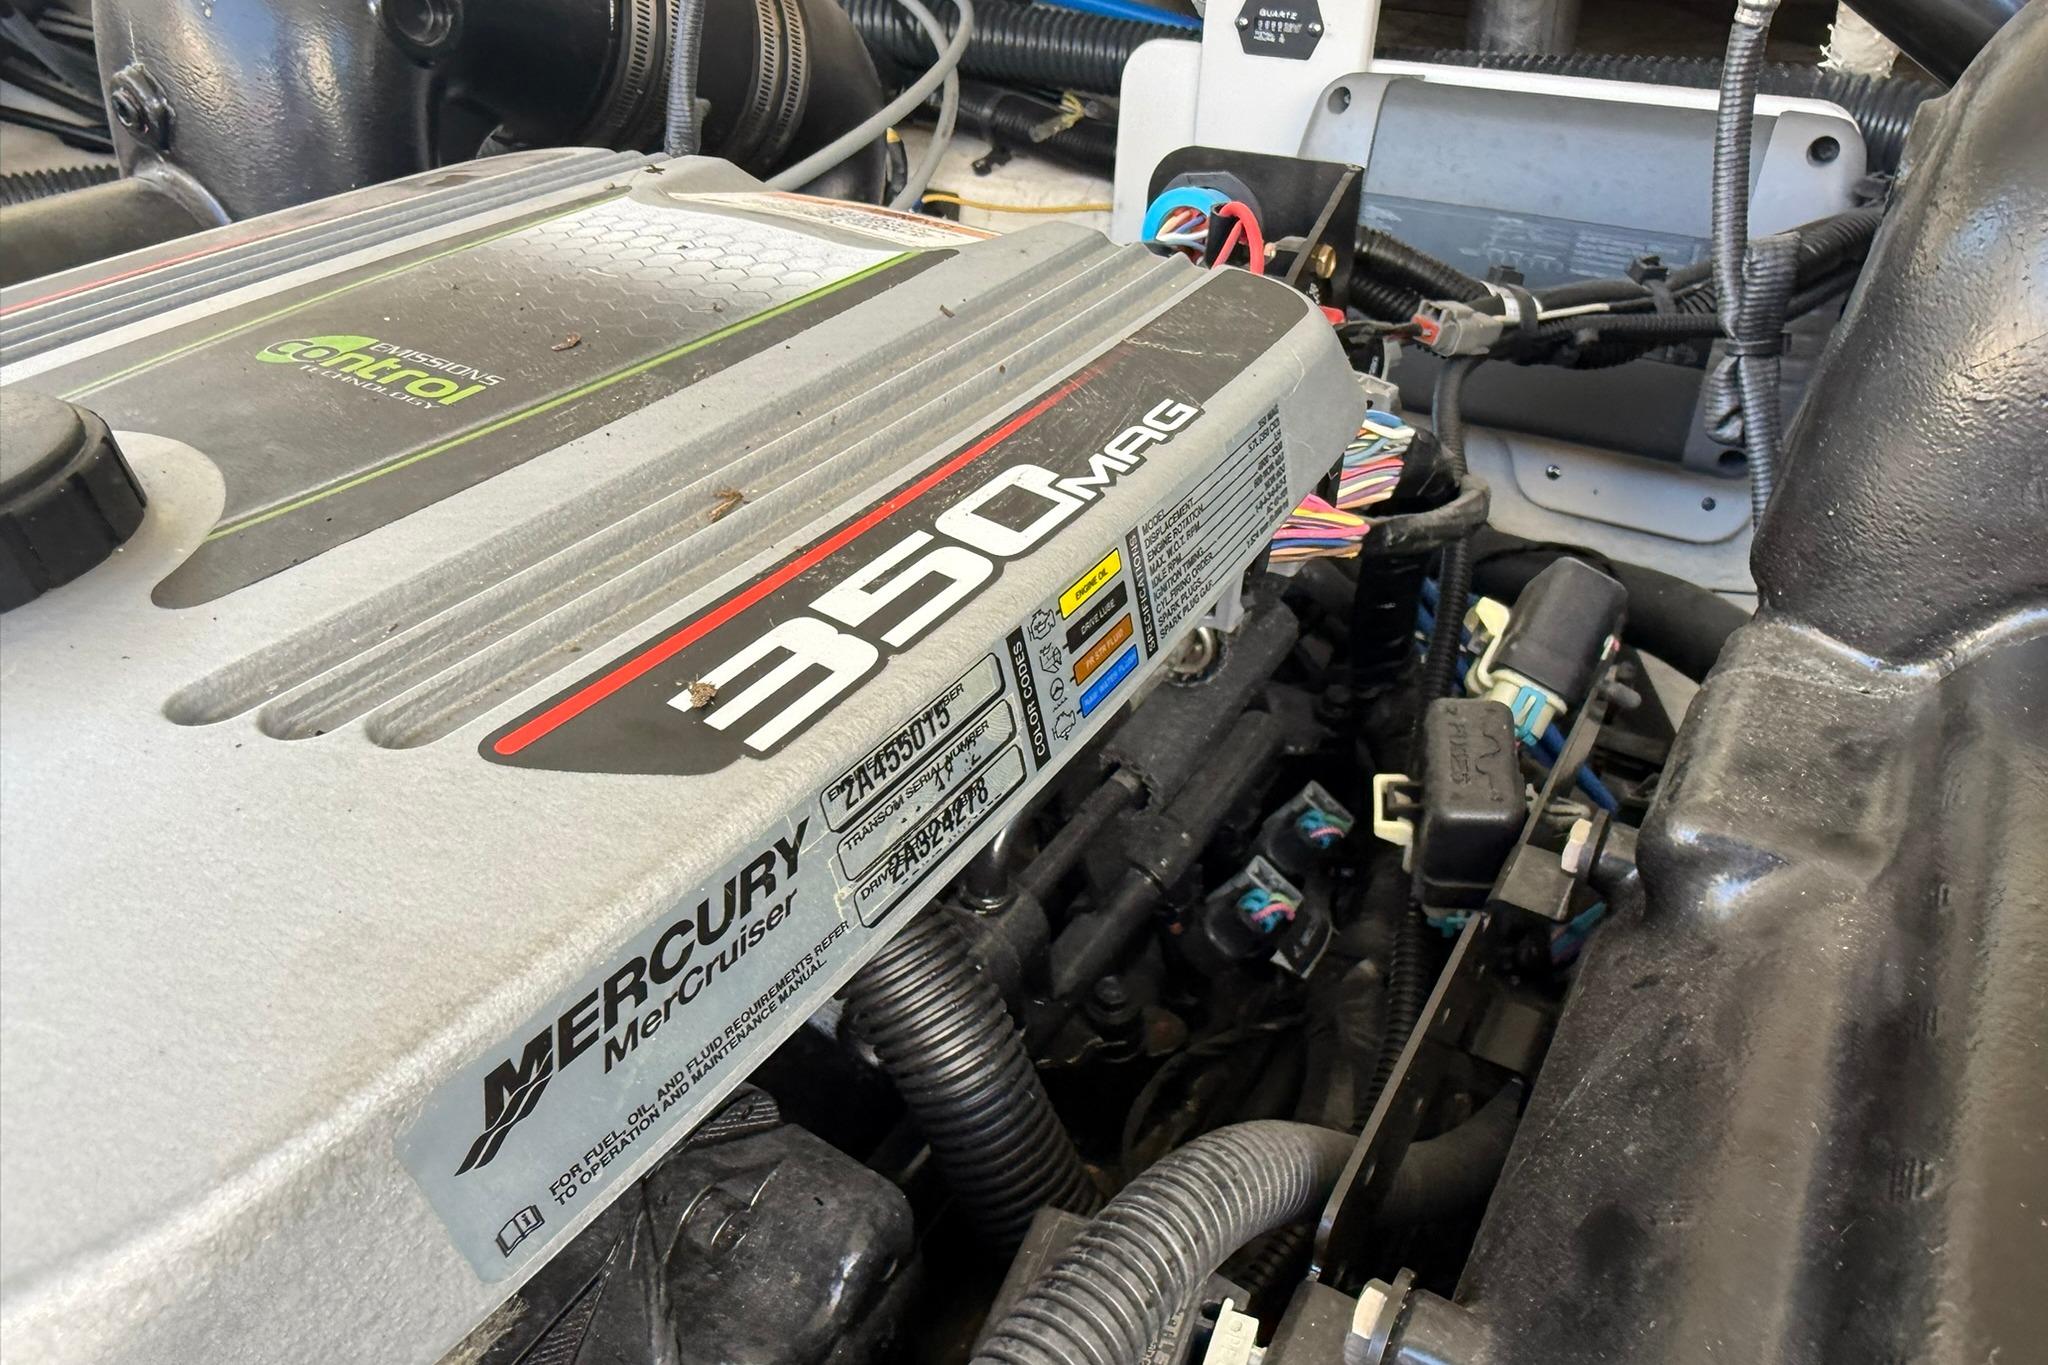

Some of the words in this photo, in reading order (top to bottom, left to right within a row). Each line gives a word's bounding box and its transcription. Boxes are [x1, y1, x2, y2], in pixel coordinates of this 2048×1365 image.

[299, 364, 441, 409] TECHNOLOGY
[369, 342, 506, 386] EMISSIONS
[1142, 509, 1164, 535] MODEL
[1144, 498, 1195, 549] DISPLACEMENT
[1147, 531, 1172, 562] ENGINE
[1172, 503, 1204, 540] ROTATION
[669, 463, 1084, 752] 350
[1056, 398, 1199, 500] MAG
[1075, 576, 1098, 601] ENGINE
[1097, 567, 1109, 580] OIL
[1151, 568, 1168, 589] IDLE
[1153, 568, 1182, 602] IGNITION
[1181, 546, 1204, 574] TIMING
[1191, 551, 1213, 577] ORDER
[1081, 614, 1099, 636] DRIVE
[1099, 598, 1117, 619] LUBE
[1129, 533, 1155, 653] SPECIFICATIONS
[1158, 601, 1180, 627] SPARK
[1180, 576, 1202, 604] PLUGS
[1159, 612, 1182, 640] SPARK
[1182, 594, 1200, 617] PLUG
[1106, 628, 1125, 648] FLUID
[1012, 640, 1034, 700] CODES
[845, 703, 951, 811] 2A455015
[1027, 702, 1047, 758] COLOR
[843, 793, 905, 851] TRANSOM
[905, 762, 947, 799] SERIAL
[945, 719, 990, 763] NUMBER
[484, 816, 810, 1132] MERCURY
[604, 889, 798, 1074] MerCruiser
[549, 1163, 583, 1197] FOR
[583, 1129, 627, 1166] FUEL,
[627, 1103, 656, 1126] OIL,
[657, 1071, 685, 1102] AND
[686, 1036, 723, 1074] FLUID
[724, 952, 814, 1040] REQUIREMENTS
[814, 920, 850, 957] REFER
[555, 1184, 578, 1206] TO
[580, 1108, 661, 1186] OPERATION
[662, 1082, 690, 1113] AND
[690, 1000, 778, 1085] MAINTENANCE
